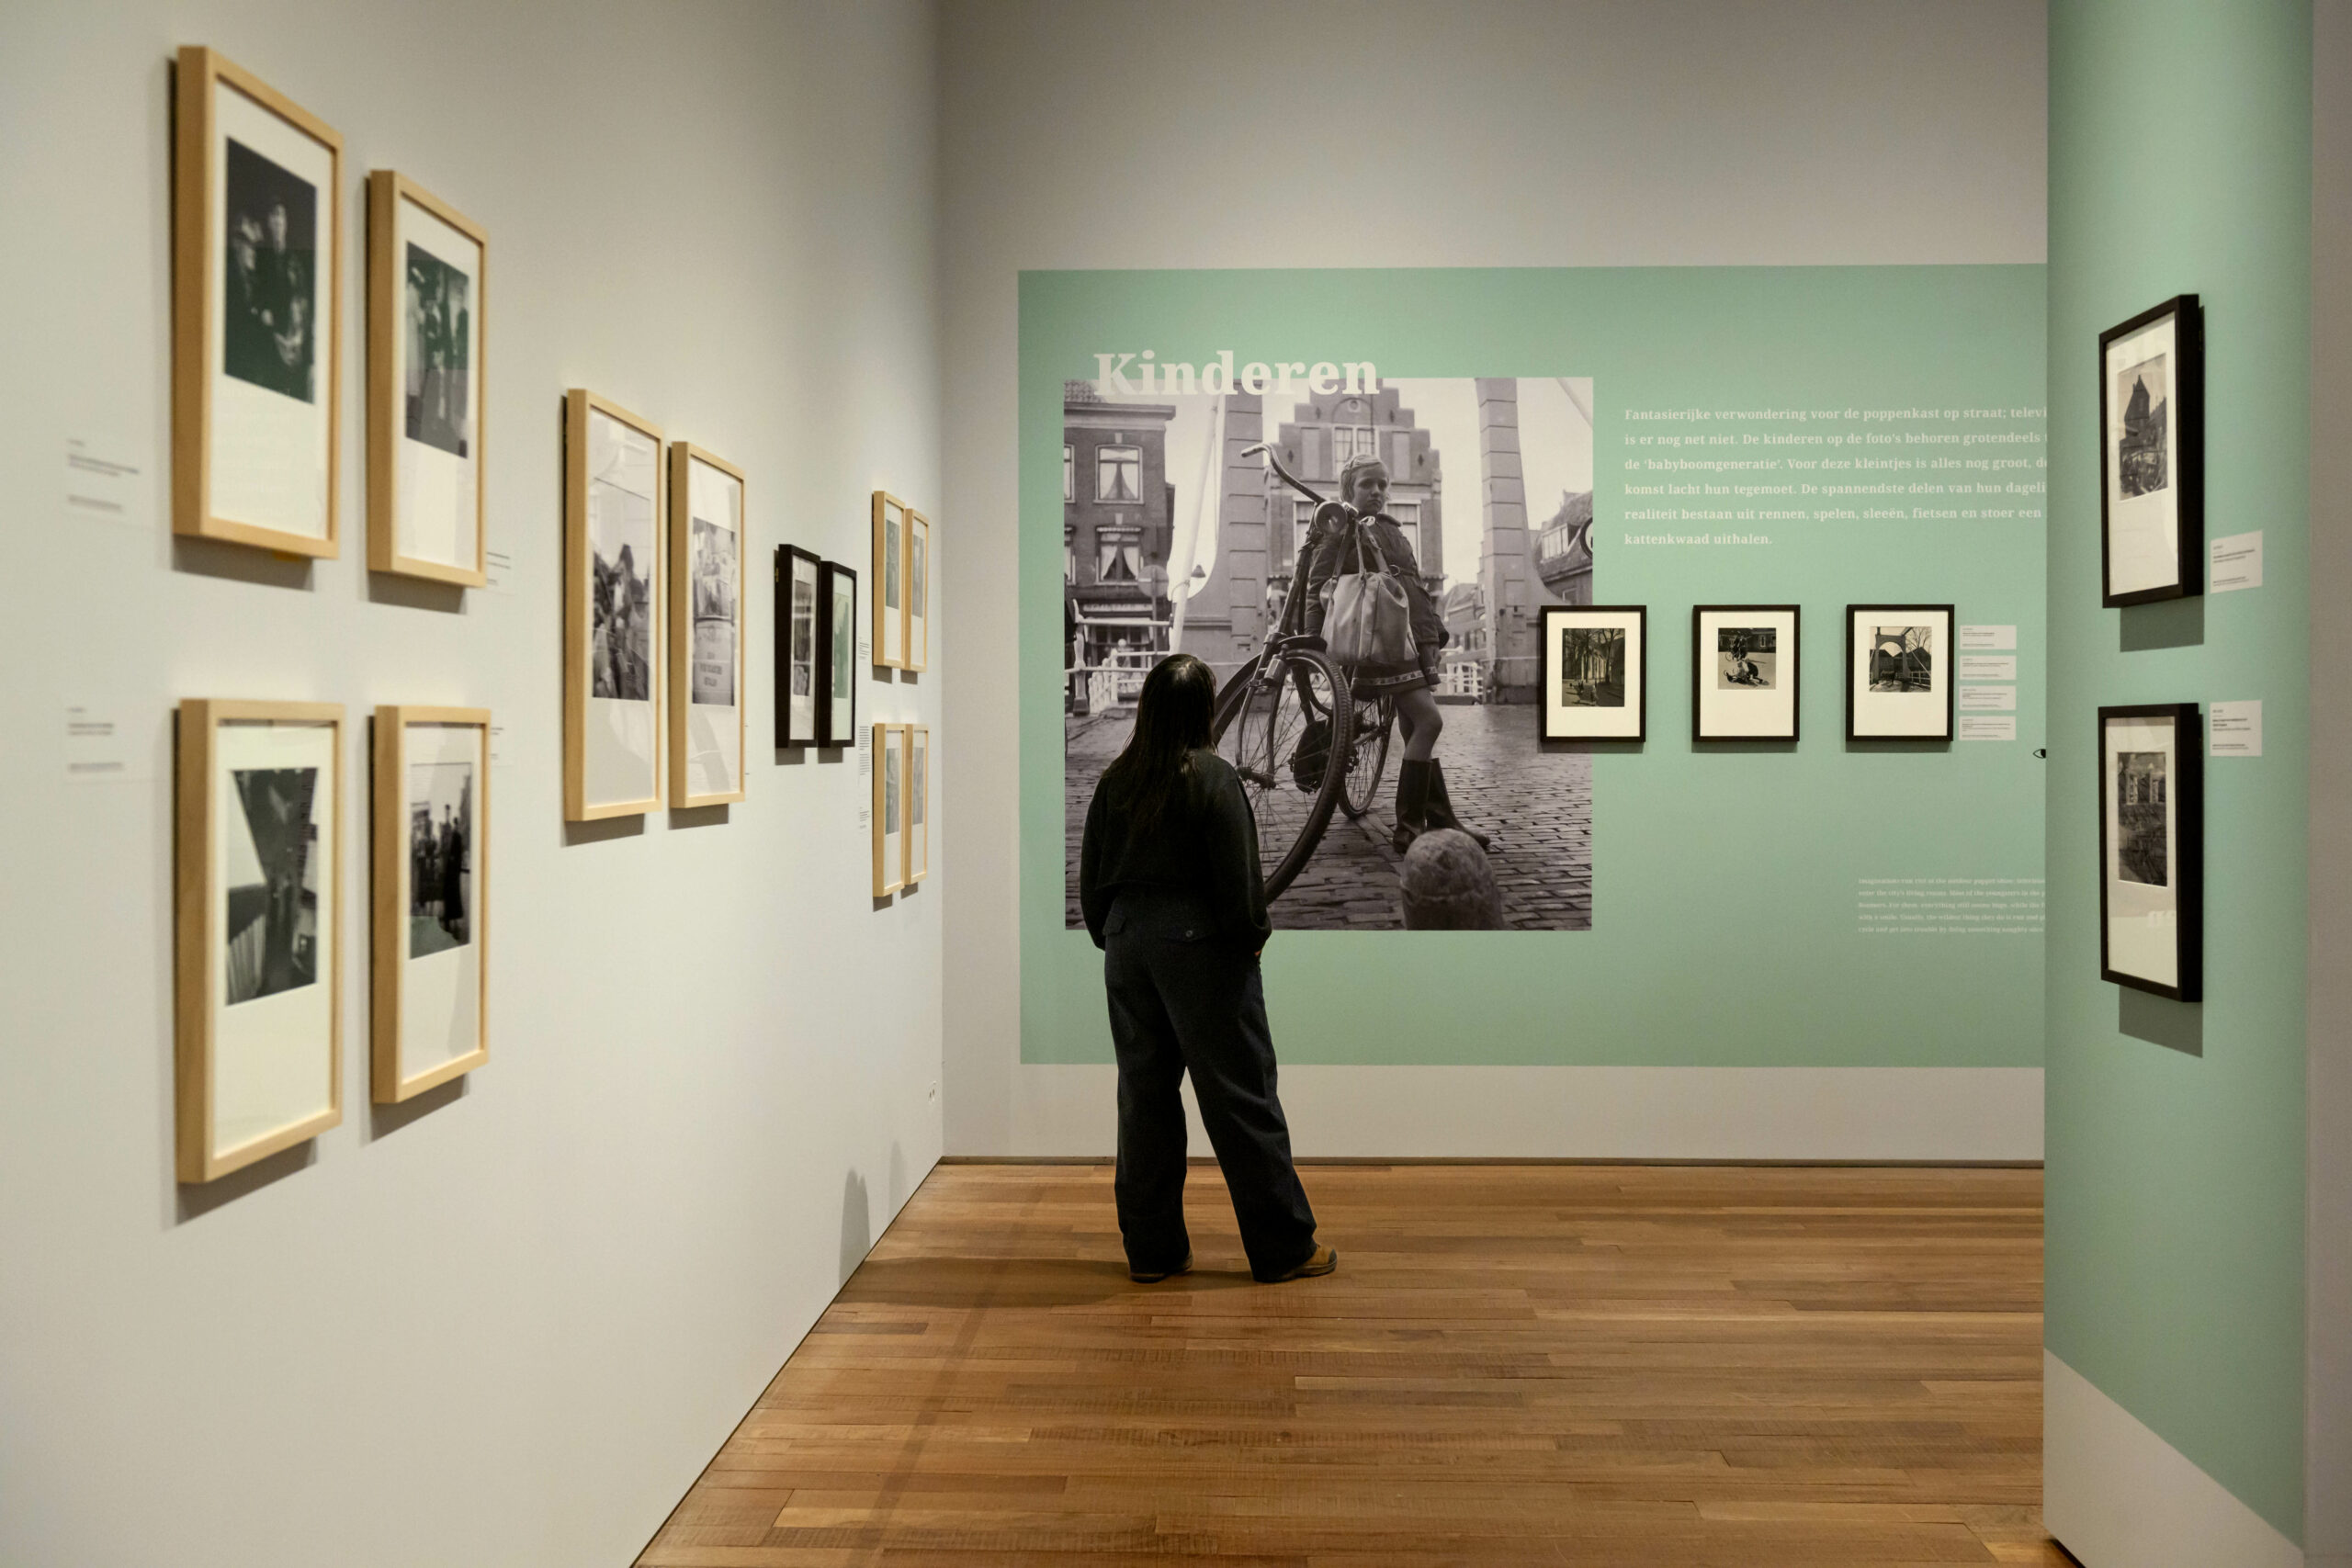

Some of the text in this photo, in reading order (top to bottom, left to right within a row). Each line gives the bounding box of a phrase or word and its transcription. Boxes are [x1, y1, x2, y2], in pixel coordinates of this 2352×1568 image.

[1093, 350, 1380, 396] Kinderen
[1625, 409, 1711, 422] Fantasierijke
[1714, 409, 1807, 422] verwondering
[1810, 411, 1840, 420] voor
[1844, 408, 1860, 419] de
[1863, 408, 1939, 422] poppenkast
[1943, 410, 1960, 421] op
[1962, 409, 2007, 420] straat;
[1624, 434, 1636, 445] is
[1639, 436, 1654, 445] er
[1657, 436, 1681, 447] nog
[1684, 435, 1705, 445] net
[1709, 434, 1738, 445] niet.
[1743, 434, 1759, 445] De
[1763, 434, 1823, 445] kinderen
[1826, 436, 1843, 446] op
[1846, 434, 1862, 444] de
[1905, 433, 1960, 444] behoren
[1962, 432, 2041, 446] grotendeels
[1624, 459, 1640, 469] de
[1787, 459, 1817, 469] Voor
[1821, 458, 1851, 469] deze
[1854, 458, 1912, 471] kleintjes
[1916, 458, 1927, 468] is
[1930, 458, 1962, 468] alles
[1965, 460, 1989, 471] nog
[1992, 459, 2032, 471] groot,
[1624, 484, 1665, 495] komst
[1668, 484, 1701, 494] lacht
[1704, 484, 1730, 494] hun
[1734, 485, 1797, 497] tegemoet.
[1801, 484, 1818, 494] De
[1822, 483, 1905, 497] spannendste
[1908, 483, 1944, 493] delen
[1948, 484, 1973, 493] van
[1976, 482, 2002, 493] hun
[1624, 508, 2041, 523] realiteit bestaan uit rennen, spelen, sleeën, fietsen en stoer een
[1624, 534, 1772, 545] kattenkwaad uithalen.
